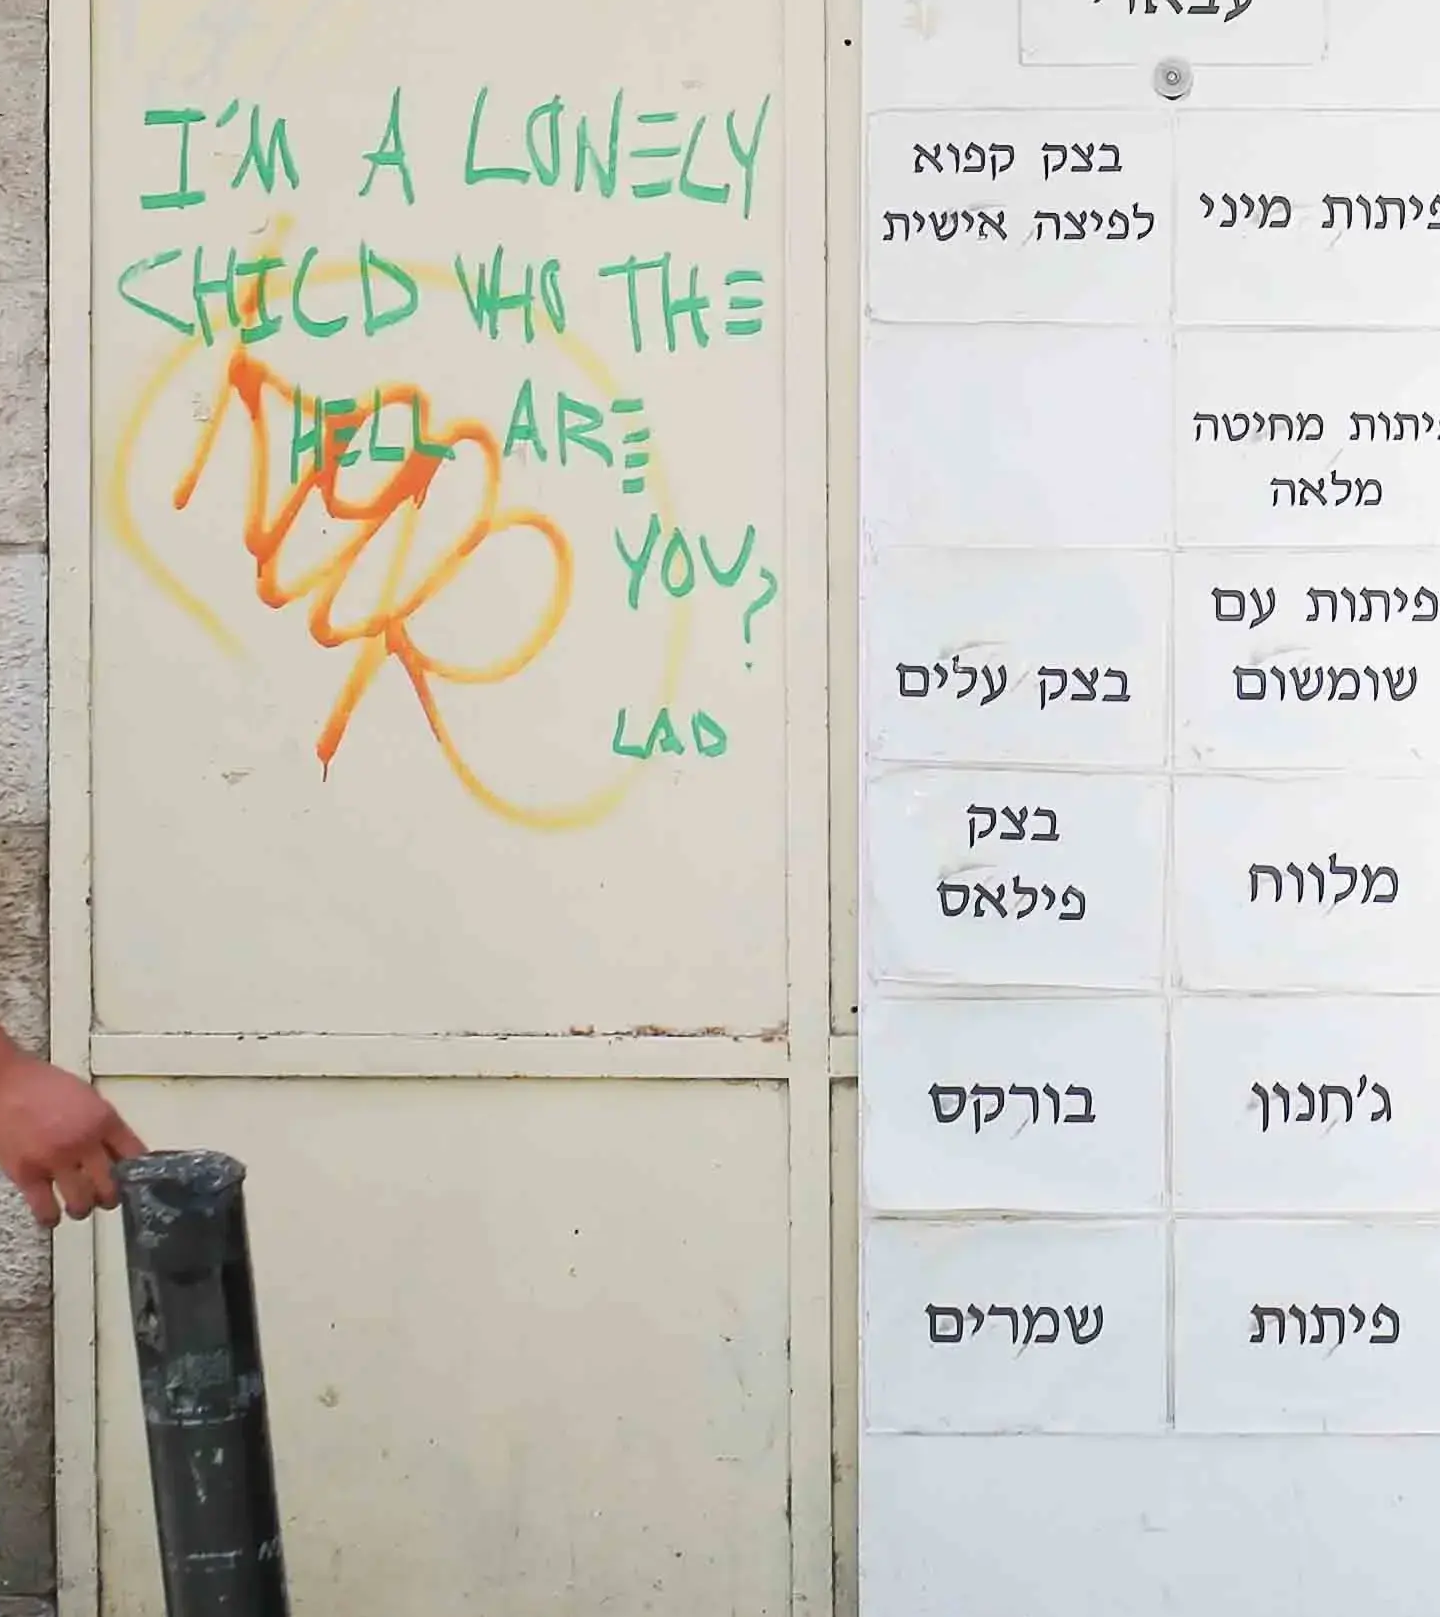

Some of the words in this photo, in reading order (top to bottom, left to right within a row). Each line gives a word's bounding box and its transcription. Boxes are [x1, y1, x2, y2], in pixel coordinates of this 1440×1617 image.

[359, 86, 414, 204] A
[463, 86, 770, 219] LONELY
[913, 141, 1015, 181] קפוא
[1041, 142, 1123, 181] בצק
[882, 210, 1008, 242] אישית
[1033, 201, 1155, 241] לפיצה
[1199, 192, 1292, 230] מיני
[118, 240, 419, 346] CHILD
[455, 244, 566, 343] WHO
[598, 251, 764, 352] THE
[290, 386, 456, 483] HELL
[505, 380, 650, 494] ARE
[1192, 411, 1324, 442] מחיטה
[1270, 469, 1383, 507] מלאה
[1210, 587, 1276, 630] עם
[1305, 585, 1439, 623] פיתות
[895, 656, 1008, 707] עלים
[1037, 665, 1131, 711] בצק
[1232, 665, 1418, 702] שומשום
[966, 803, 1060, 849] בצק
[936, 874, 1086, 921] פילאס
[1248, 852, 1399, 905] מלווח
[927, 1082, 1097, 1135] בורקס
[924, 1302, 1104, 1346] שמרים
[1249, 1302, 1400, 1346] פיתות
